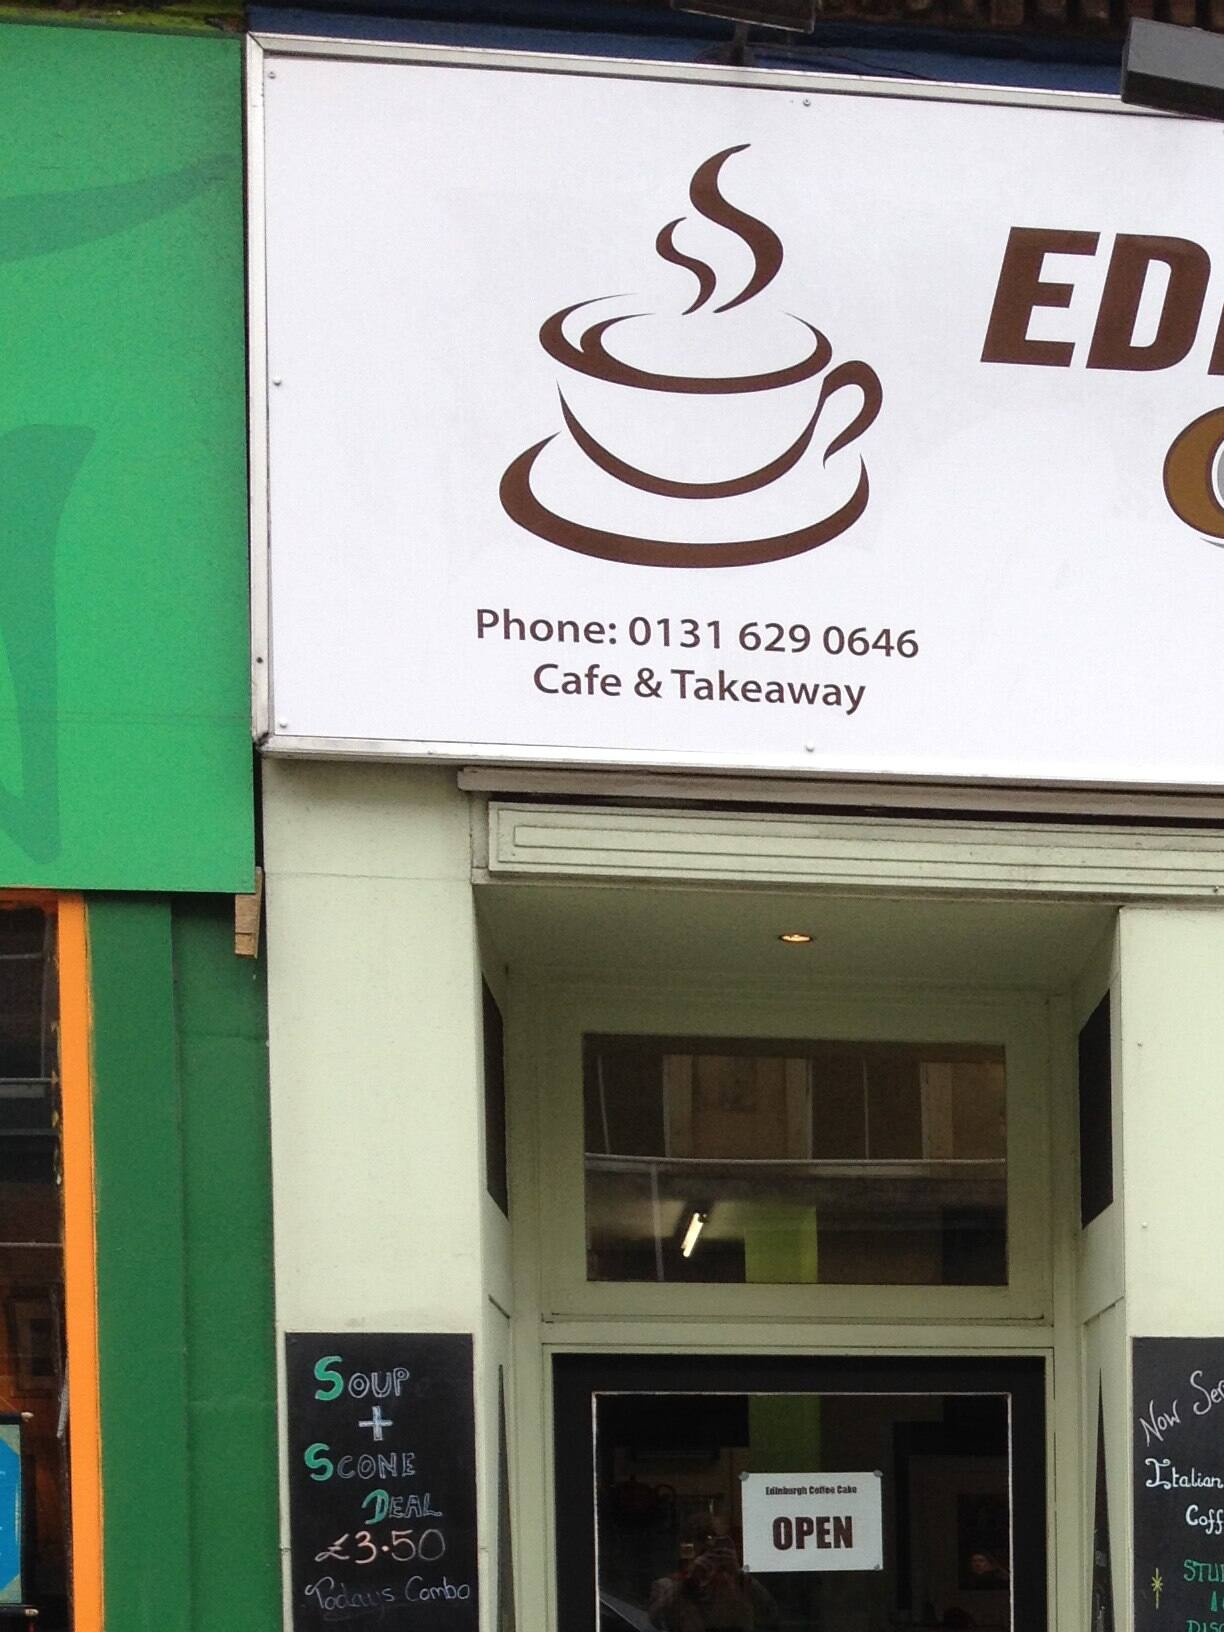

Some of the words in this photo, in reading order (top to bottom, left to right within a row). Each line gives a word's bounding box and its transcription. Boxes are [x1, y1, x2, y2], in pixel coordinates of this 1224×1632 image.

[476, 609, 617, 646] Phone:
[628, 616, 722, 651] 0131
[738, 622, 811, 655] 629
[823, 626, 919, 659] 0646
[533, 663, 621, 700] Cafe
[634, 667, 662, 701] &
[671, 668, 866, 716] Takeaway
[1140, 1399, 1181, 1446] Now
[765, 1486, 807, 1496] Edinburgh
[809, 1486, 835, 1495] Coffee
[1145, 1457, 1224, 1490] Italian
[315, 1528, 447, 1564] £3.50
[772, 1515, 854, 1551] OPEN
[405, 1575, 471, 1602] Combo
